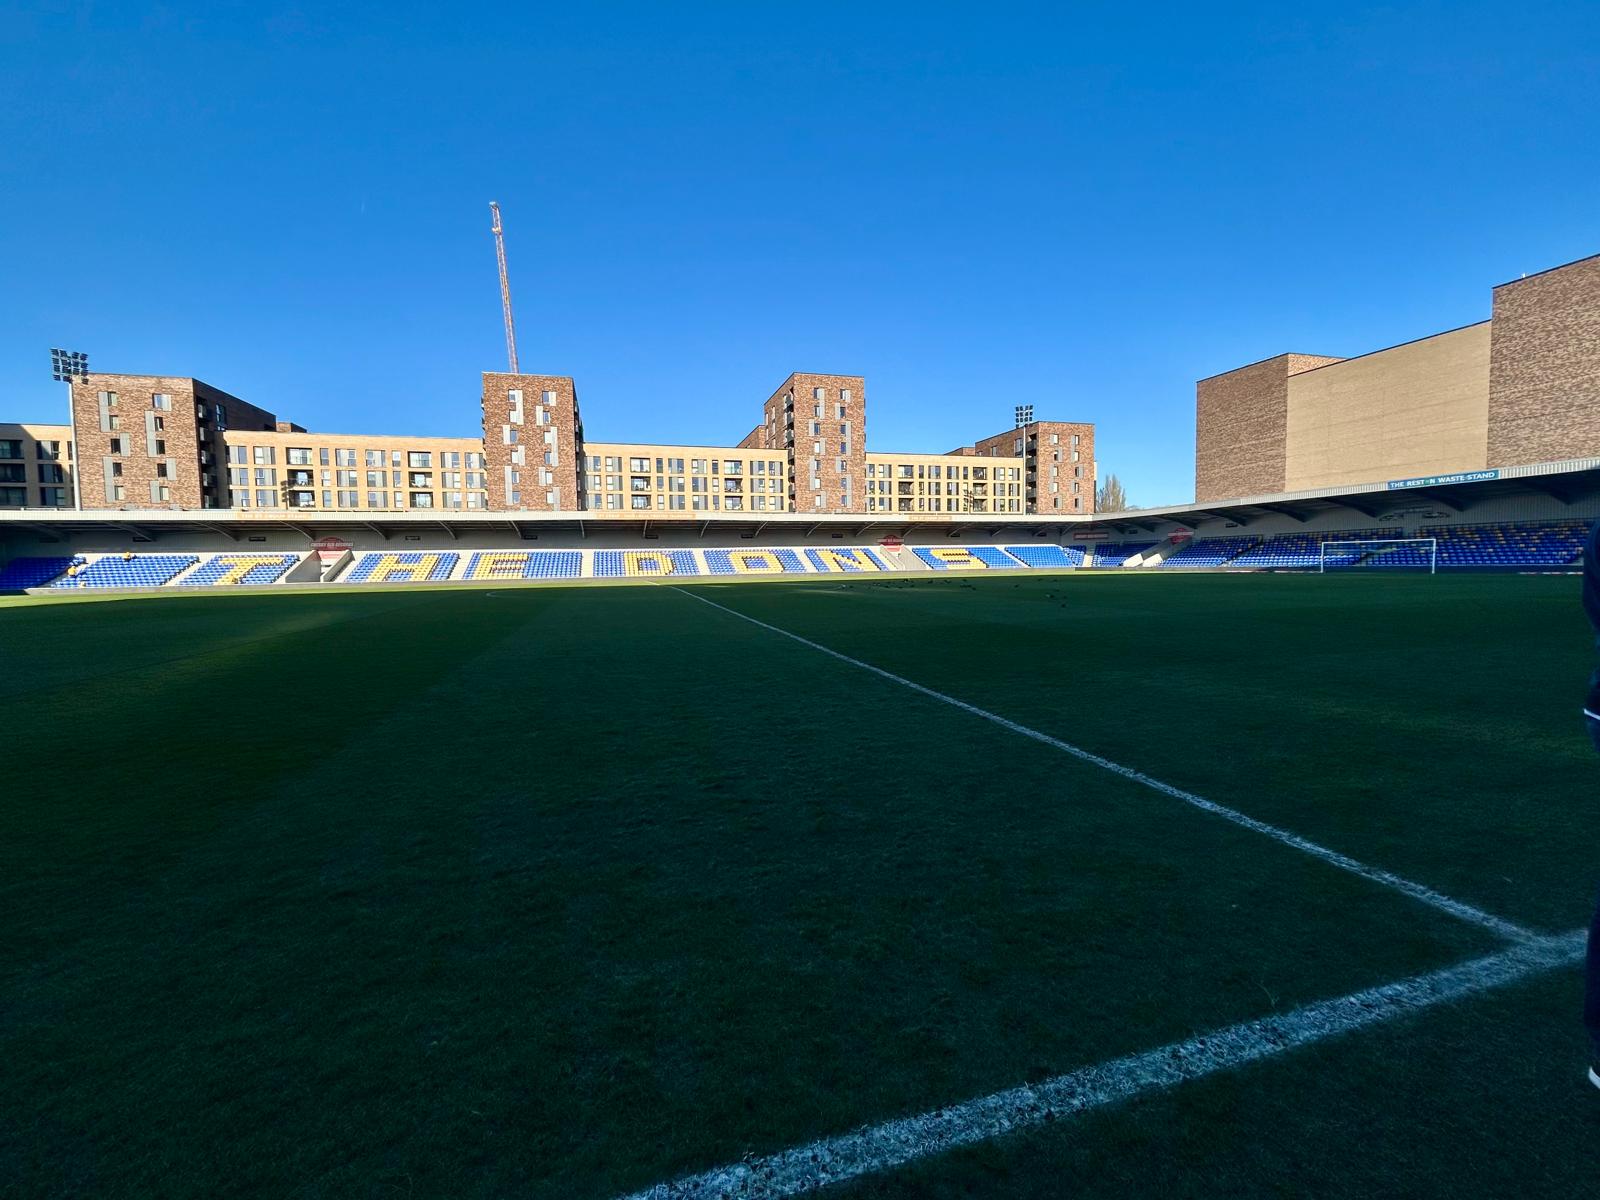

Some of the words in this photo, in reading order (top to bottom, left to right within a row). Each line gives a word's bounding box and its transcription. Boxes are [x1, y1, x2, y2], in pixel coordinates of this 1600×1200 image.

[1390, 481, 1404, 489] THE
[1438, 475, 1465, 484] WASTE
[1467, 471, 1496, 480] STAND
